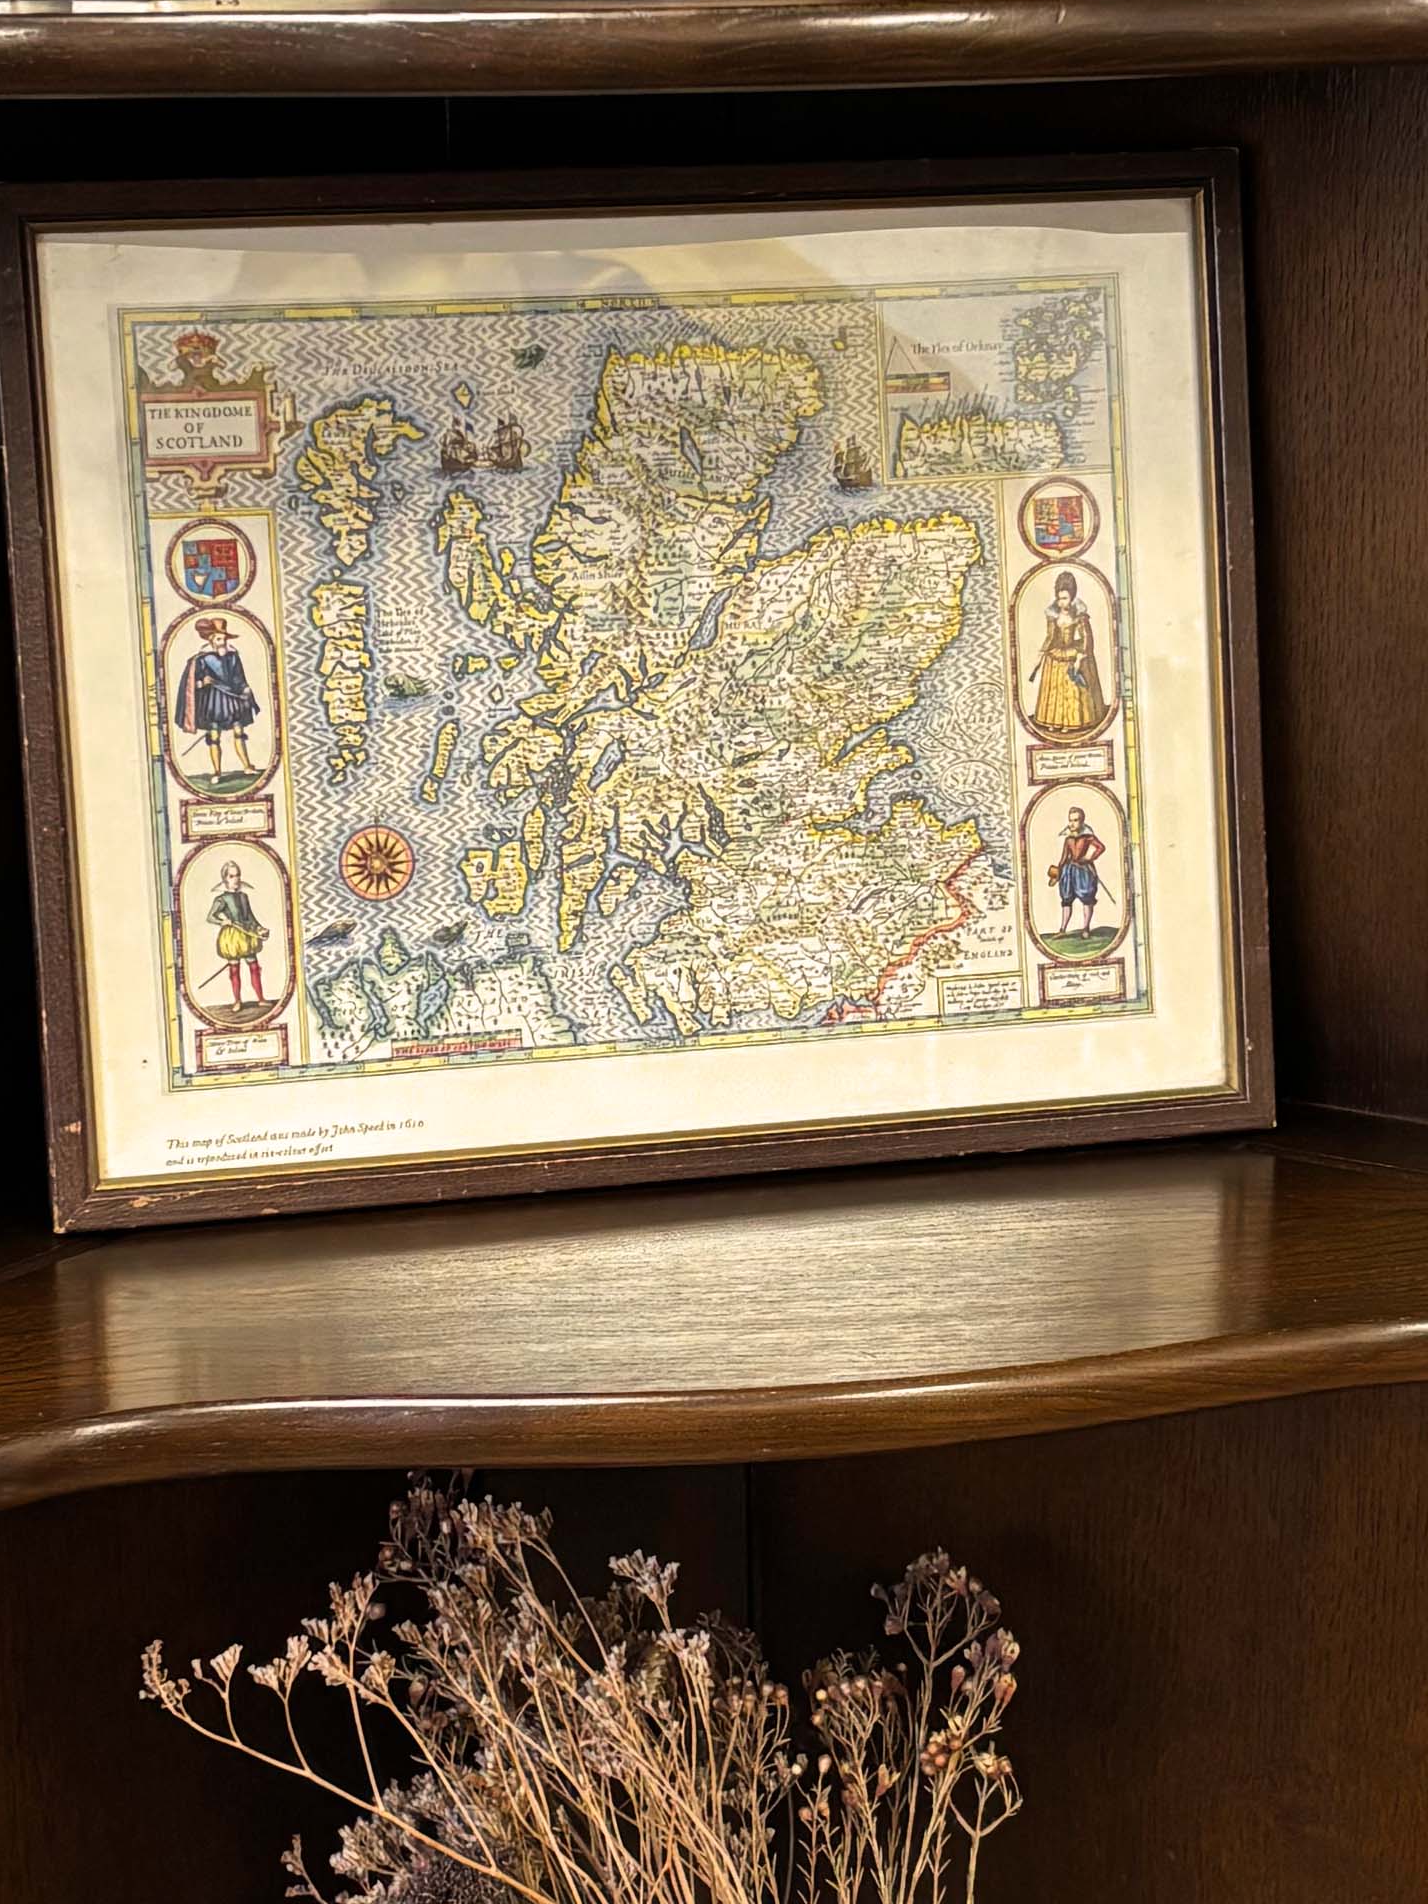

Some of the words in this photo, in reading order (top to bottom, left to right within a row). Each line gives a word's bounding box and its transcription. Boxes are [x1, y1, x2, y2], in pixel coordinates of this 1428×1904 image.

[174, 405, 253, 419] KINGDOME
[183, 422, 205, 434] OF
[155, 435, 243, 450] SCOTLAND
[399, 1118, 425, 1130] 1610
